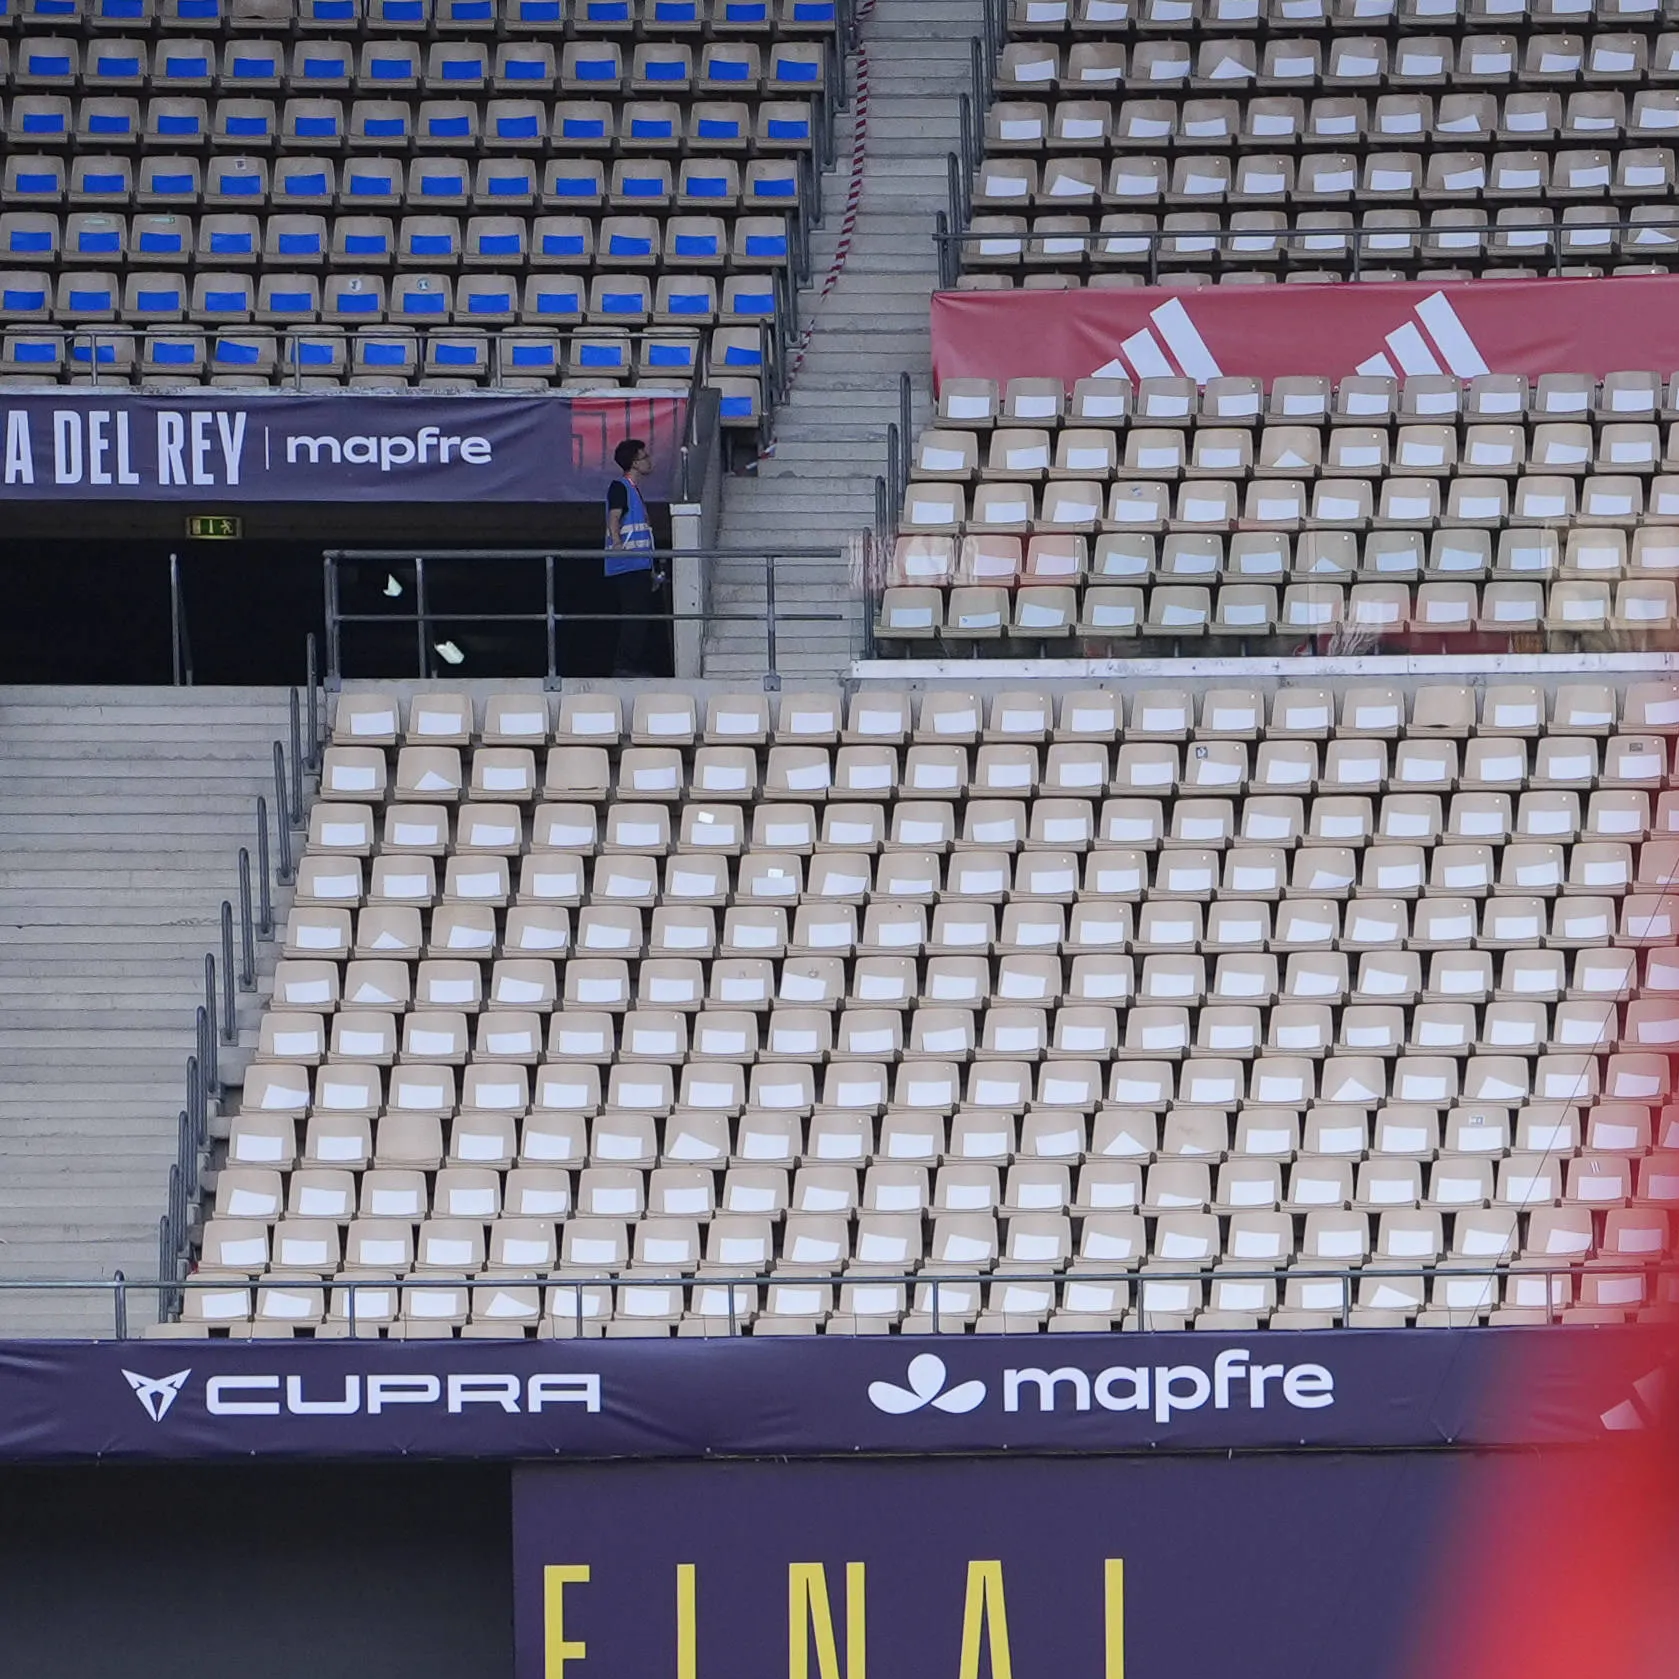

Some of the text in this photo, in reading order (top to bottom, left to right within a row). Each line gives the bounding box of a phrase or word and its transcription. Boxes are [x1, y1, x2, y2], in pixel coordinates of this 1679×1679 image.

[53, 410, 140, 485] DEL
[157, 411, 247, 485] REY
[286, 426, 492, 472] mapfre
[206, 1373, 601, 1415] CUPRA
[1003, 1348, 1334, 1423] mapfre
